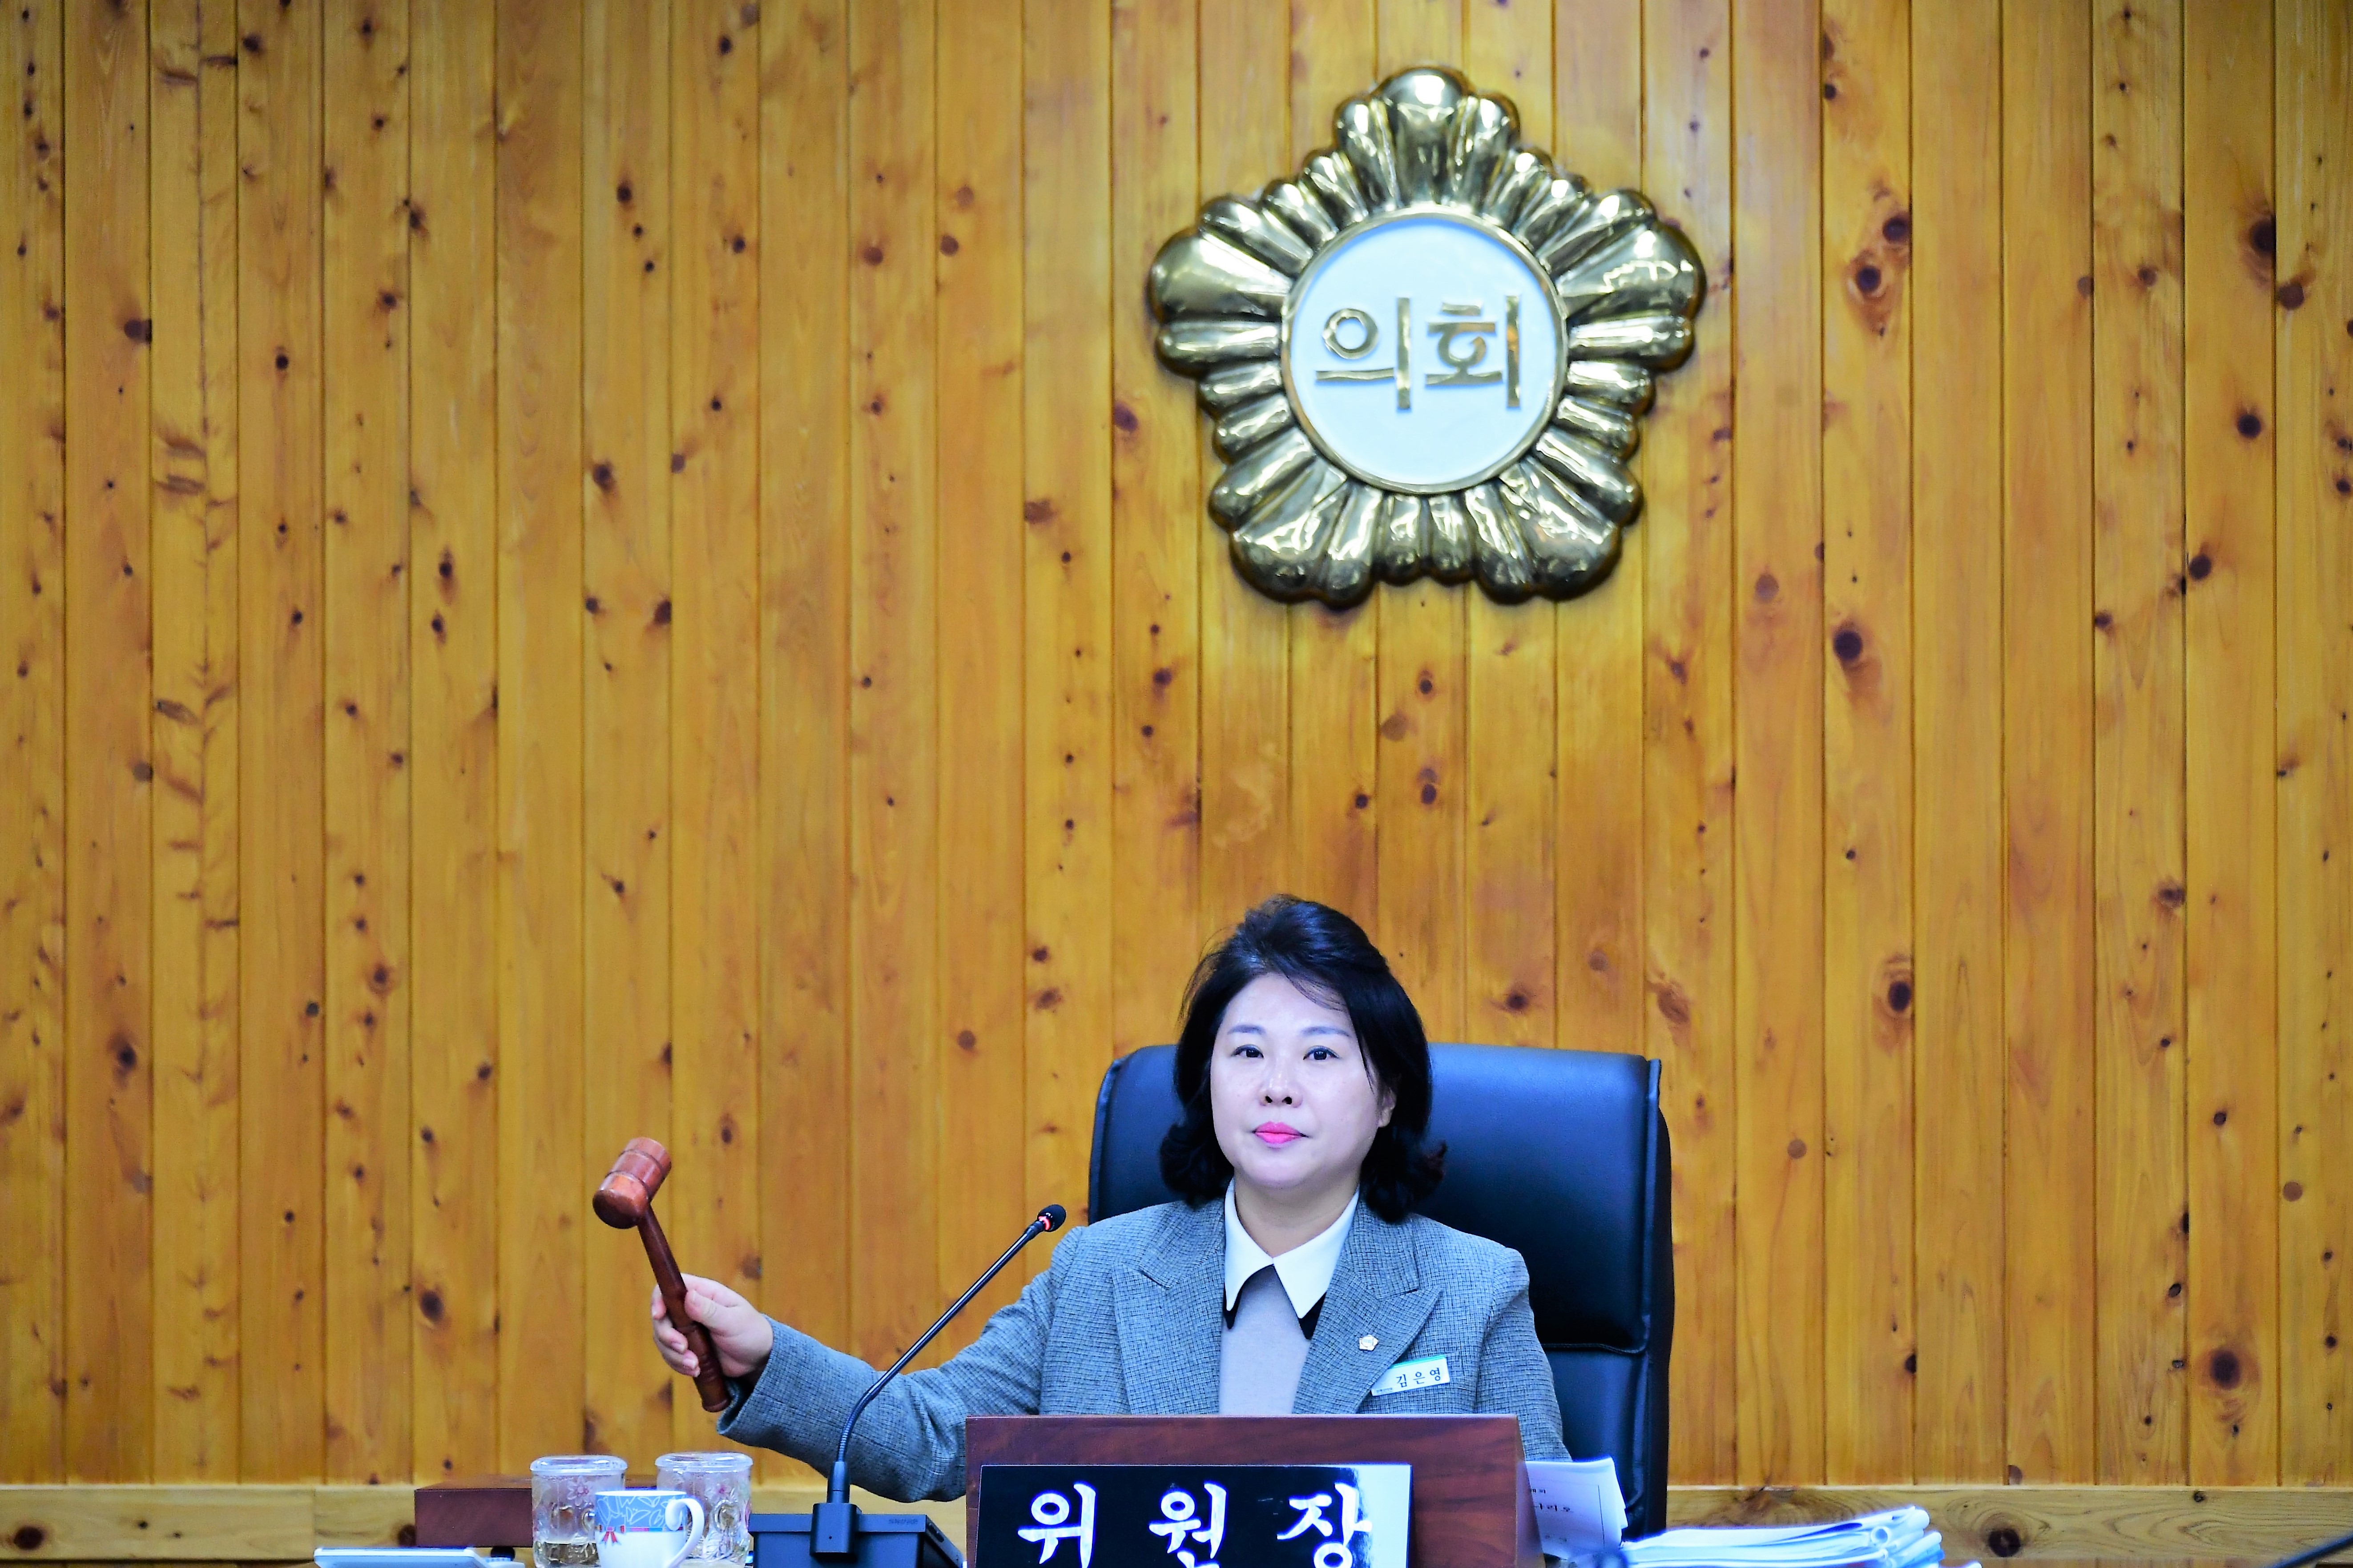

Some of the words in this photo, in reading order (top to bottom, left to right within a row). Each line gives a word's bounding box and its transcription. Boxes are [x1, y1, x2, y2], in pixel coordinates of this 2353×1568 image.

[1315, 296, 1520, 410] 의회
[1396, 1367, 1441, 1387] 김은영
[1017, 1483, 1373, 1568] 위원장
